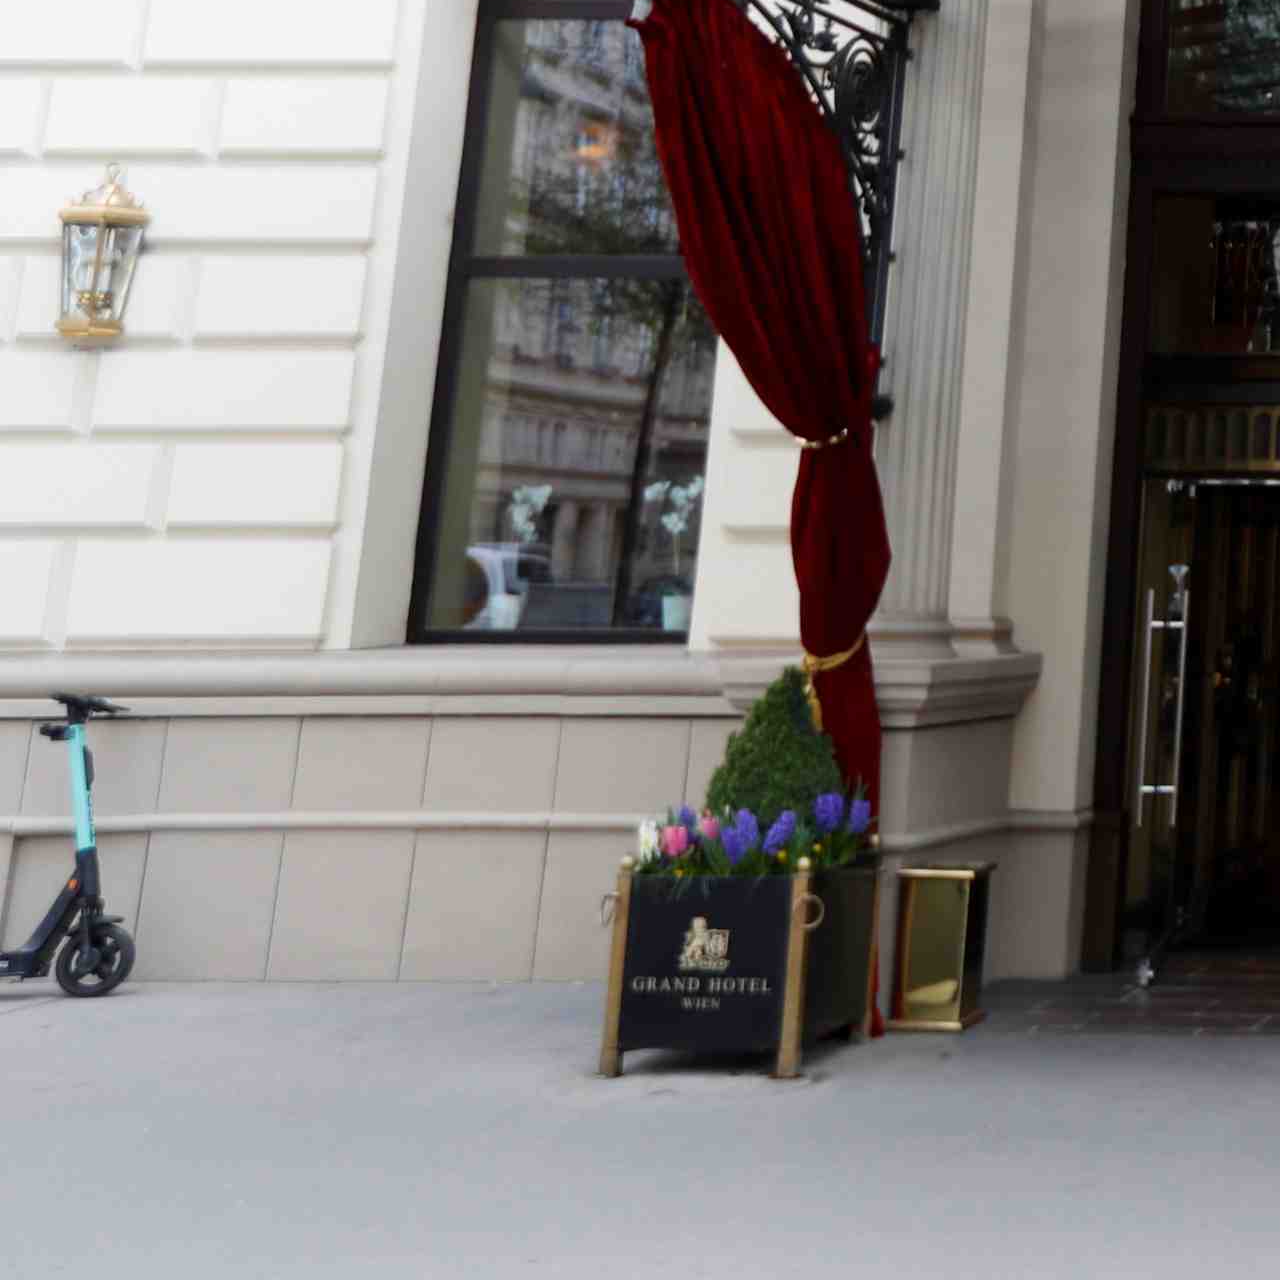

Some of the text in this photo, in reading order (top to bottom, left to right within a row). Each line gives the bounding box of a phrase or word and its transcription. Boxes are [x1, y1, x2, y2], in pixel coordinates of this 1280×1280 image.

[632, 975, 772, 994] GRAND HOTEL
[682, 996, 721, 1011] WIEN
